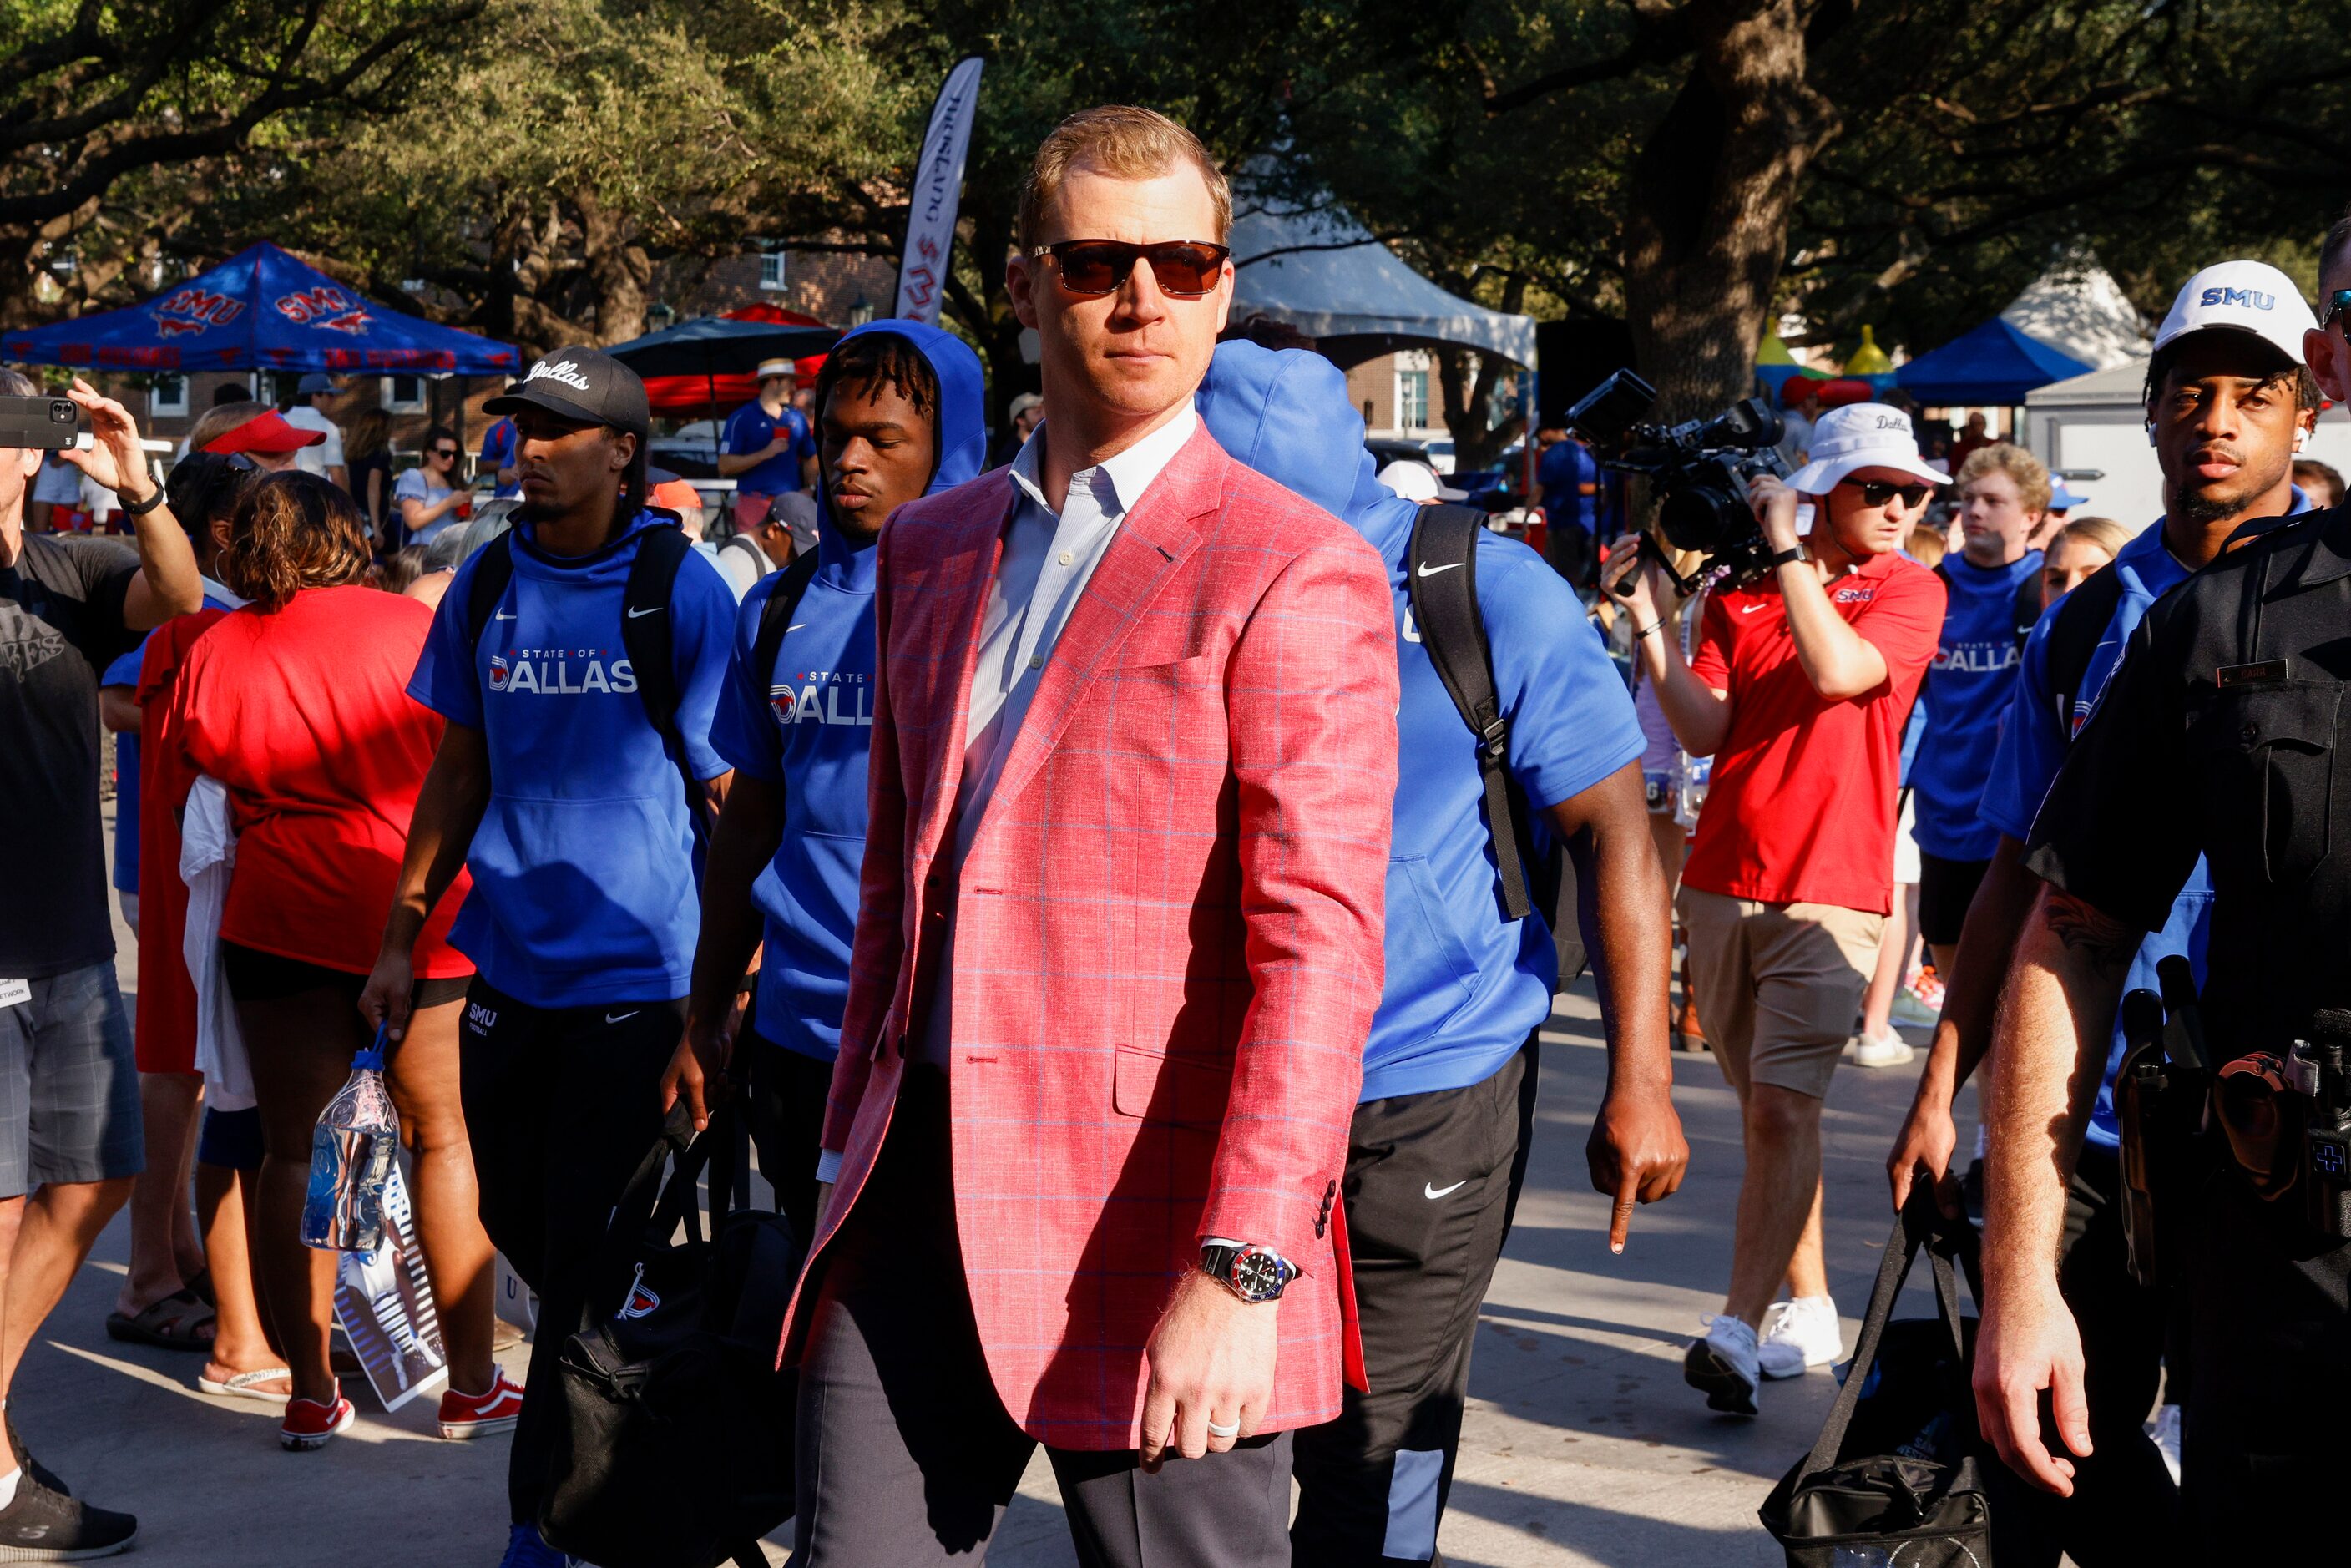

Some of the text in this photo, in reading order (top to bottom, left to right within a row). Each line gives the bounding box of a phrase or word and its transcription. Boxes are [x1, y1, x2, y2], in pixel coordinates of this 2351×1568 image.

[2200, 287, 2276, 311] SMU
[523, 360, 589, 391] Dallas
[1837, 589, 1875, 603] SMU
[522, 649, 596, 659] STATE OF
[489, 655, 638, 694] DALLAS
[809, 671, 863, 683] STATE
[770, 685, 873, 726] DALL
[468, 1002, 498, 1027] SMU
